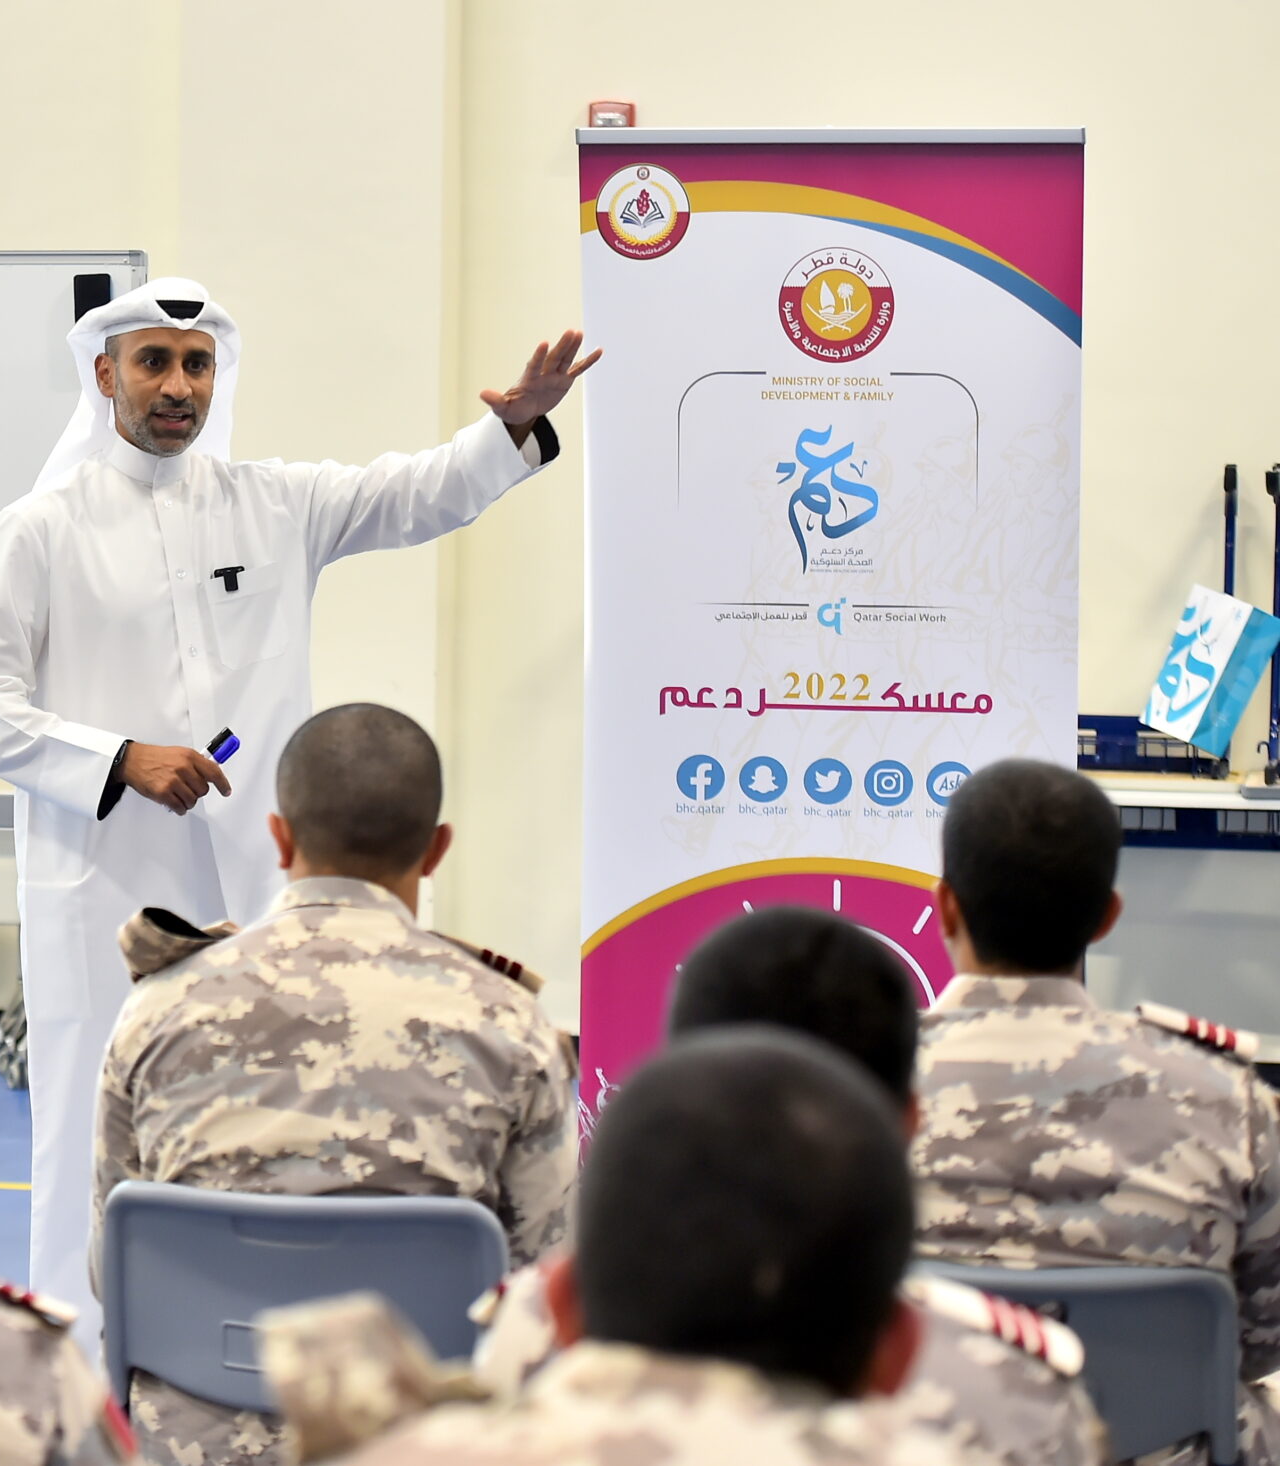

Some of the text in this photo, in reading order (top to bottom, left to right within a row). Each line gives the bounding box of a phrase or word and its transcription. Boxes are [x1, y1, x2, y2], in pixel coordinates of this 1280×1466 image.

[802, 252, 874, 280] دولة قطر
[782, 301, 891, 360] وزارة التنمية الاجتماعية والأسرة
[772, 376, 884, 387] MINISTRY OF SOCIAL
[761, 390, 894, 401] DEVELOPMENT & FAMILY
[820, 548, 842, 557] دعم
[791, 611, 808, 622] قطر
[853, 612, 947, 623] Qatar Social Work
[783, 671, 871, 701] 2022
[659, 685, 743, 716] دعم
[738, 804, 789, 817] bhc_qatar
[803, 806, 852, 818] bhc_qatar
[863, 806, 914, 819] bhc_qatar
